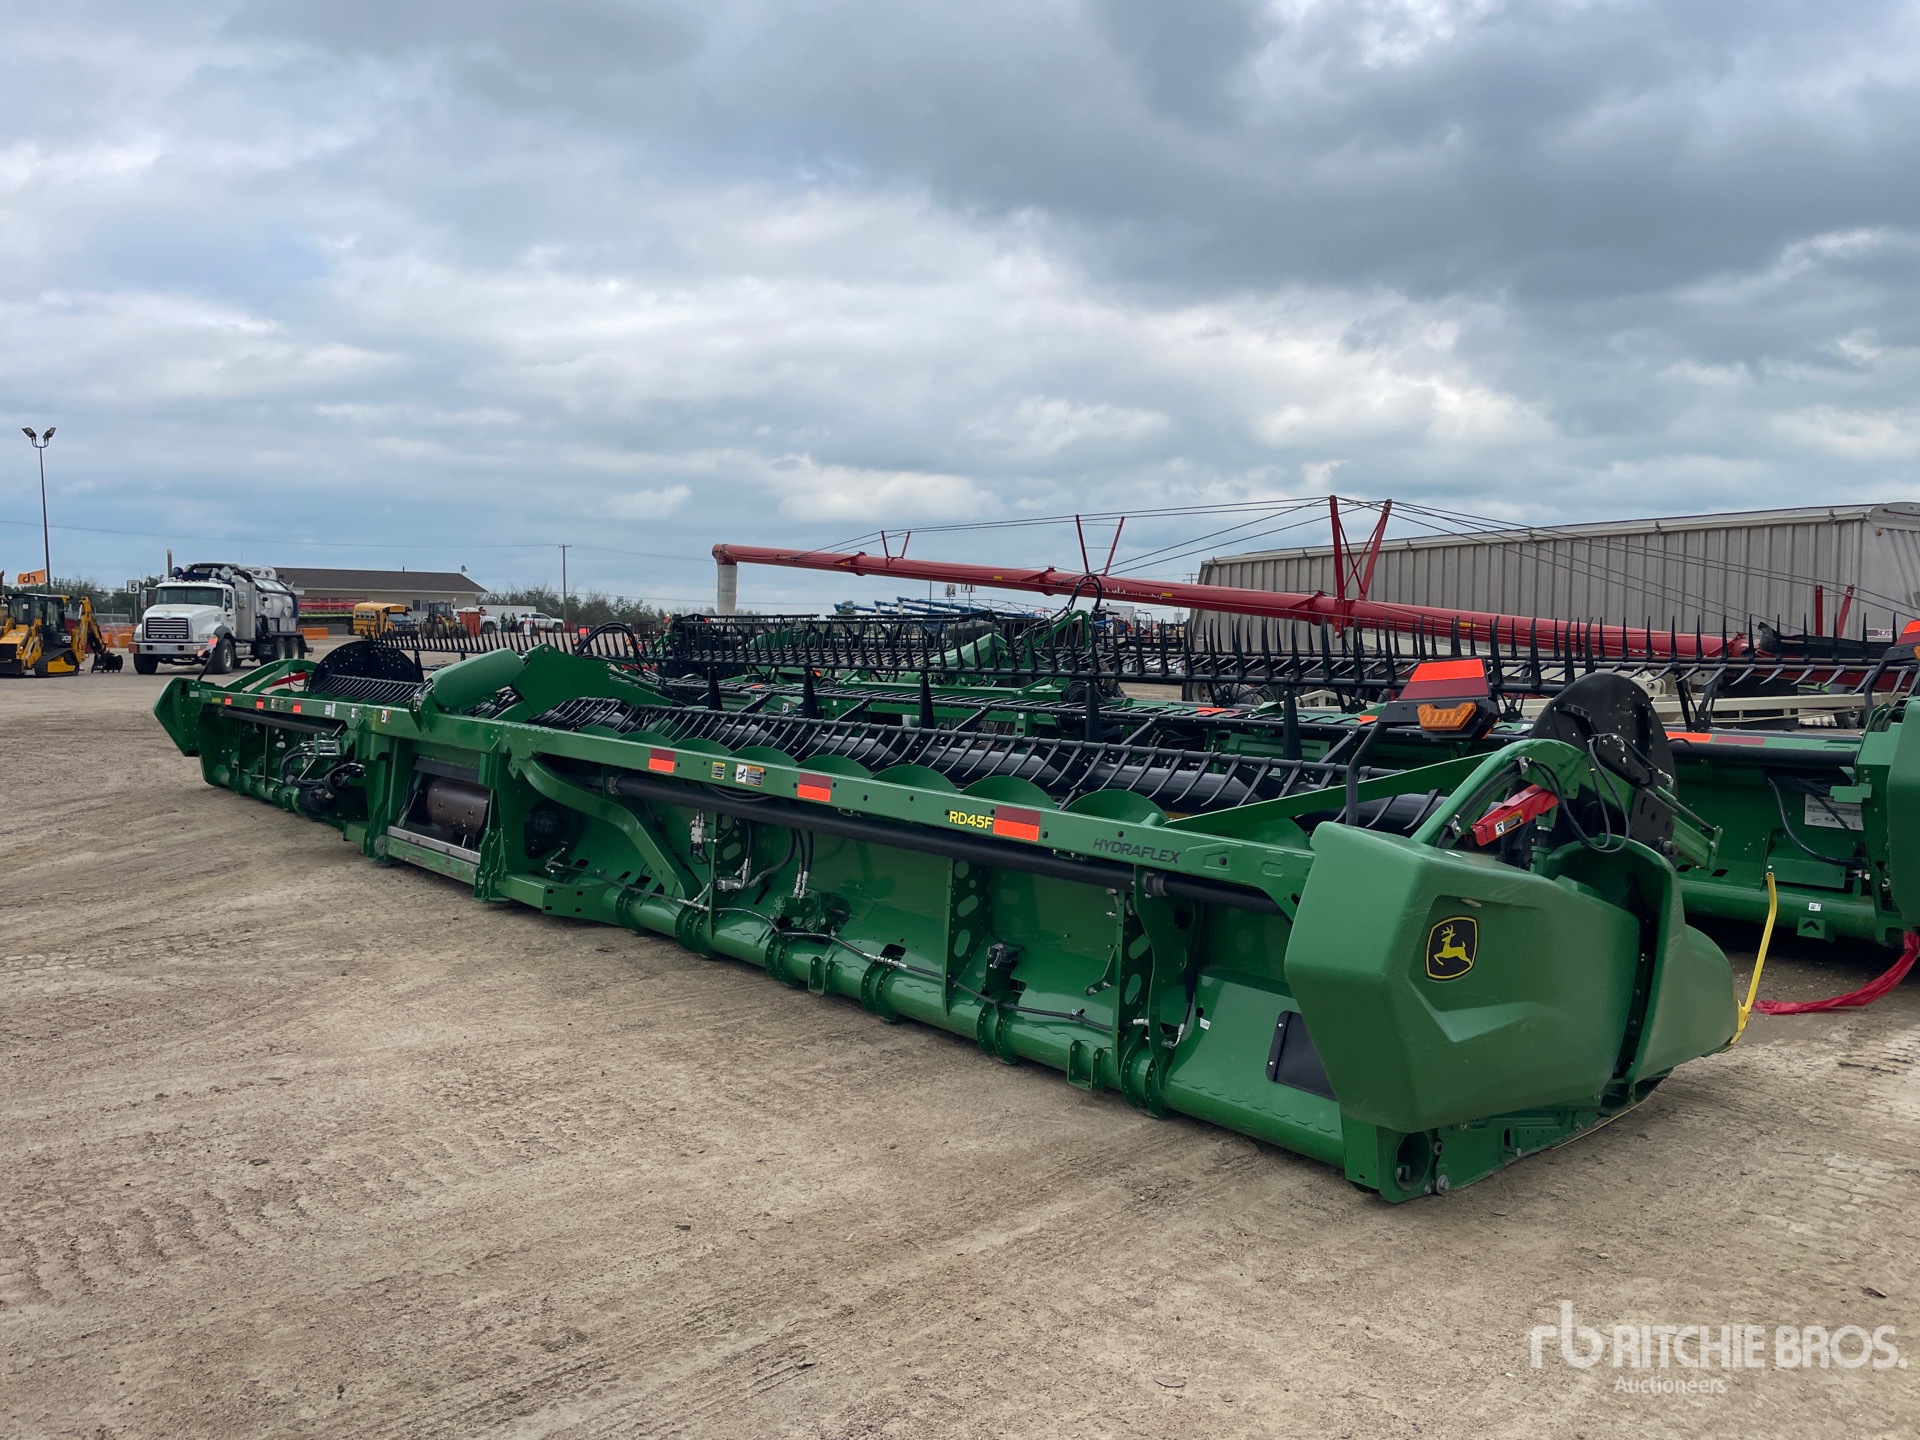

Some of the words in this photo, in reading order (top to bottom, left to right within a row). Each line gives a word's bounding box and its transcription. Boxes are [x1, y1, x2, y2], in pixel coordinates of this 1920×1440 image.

[130, 583, 137, 592] 5
[949, 810, 994, 830] RD45F
[1093, 837, 1181, 864] HYDRAFLEX
